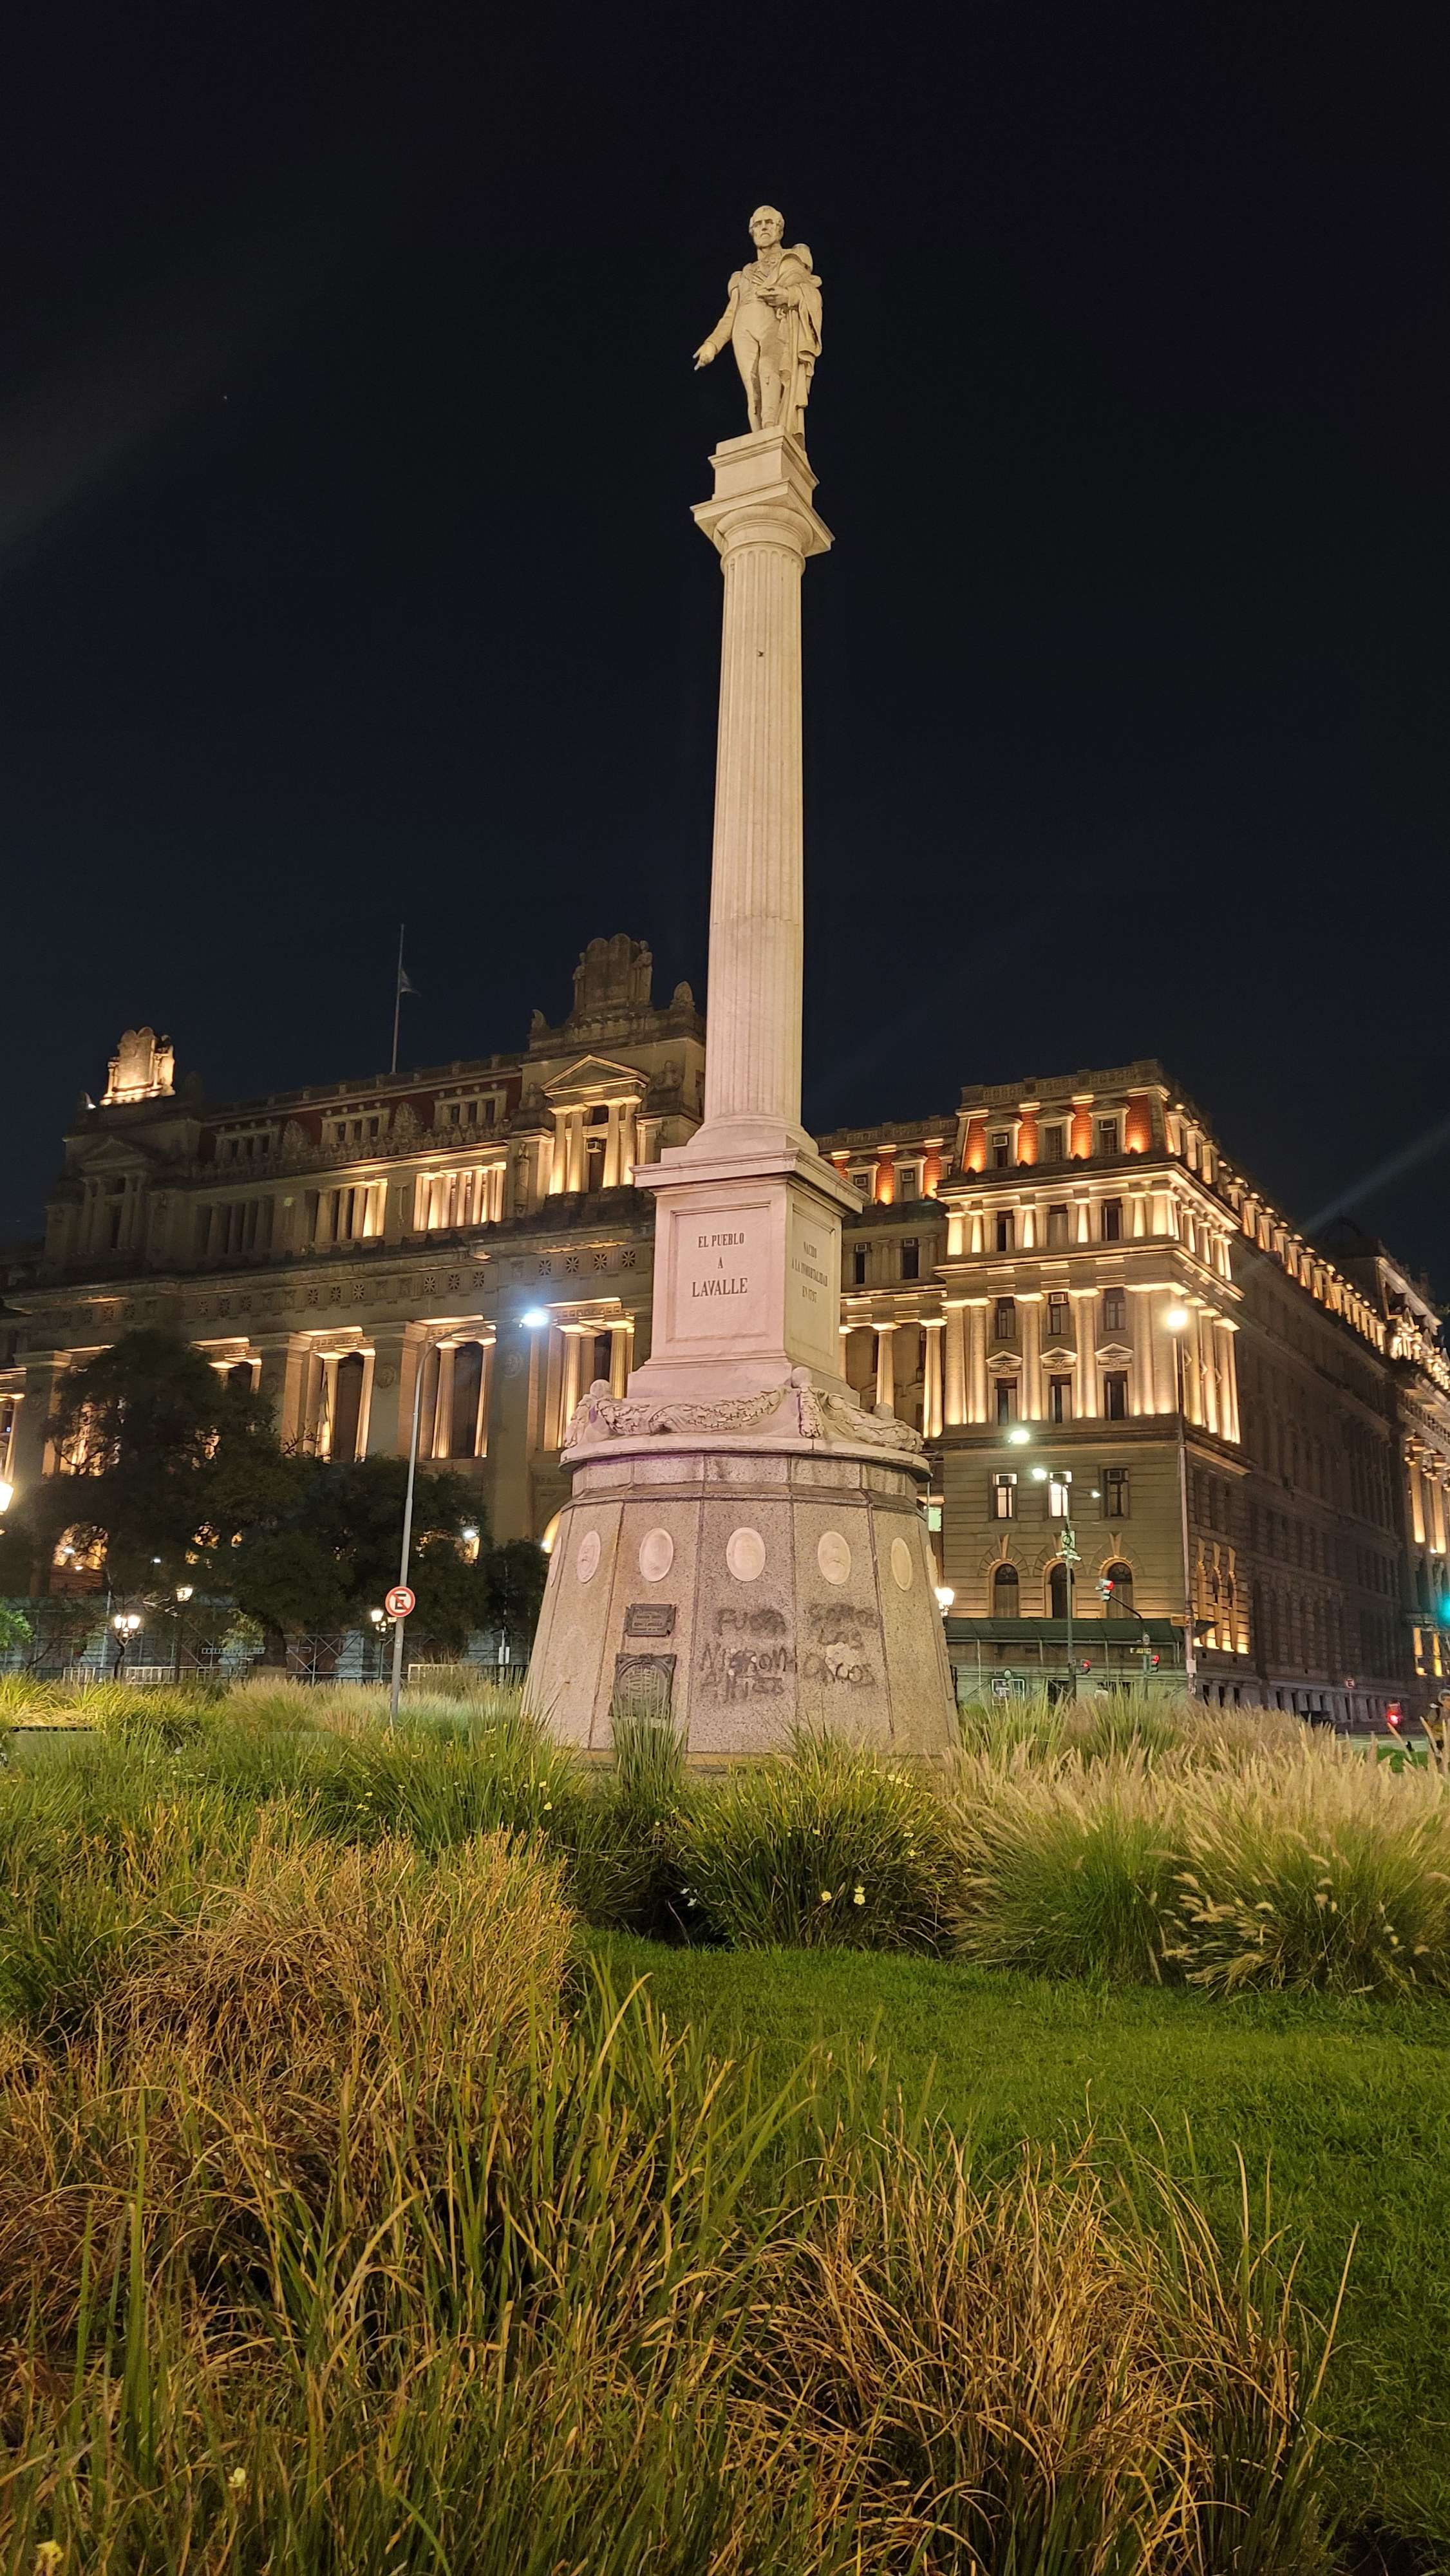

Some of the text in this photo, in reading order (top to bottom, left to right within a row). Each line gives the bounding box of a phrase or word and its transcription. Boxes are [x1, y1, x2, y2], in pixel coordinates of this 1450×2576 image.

[698, 1233, 744, 1248] EL PUEBLO
[717, 1256, 724, 1269] A
[692, 1278, 748, 1297] LAVALLE
